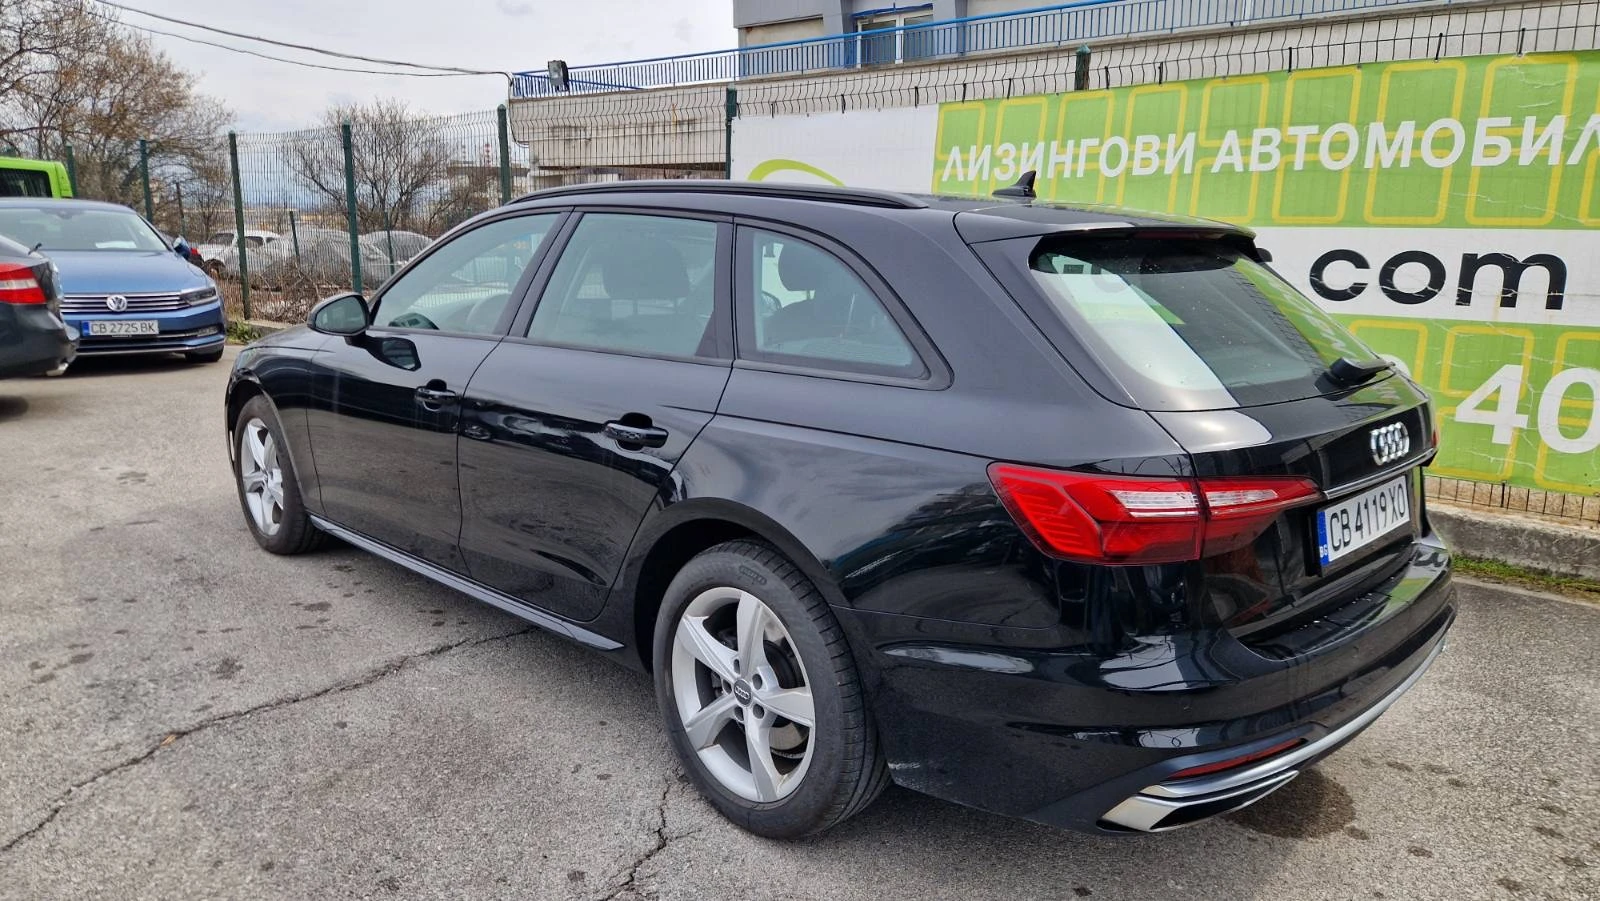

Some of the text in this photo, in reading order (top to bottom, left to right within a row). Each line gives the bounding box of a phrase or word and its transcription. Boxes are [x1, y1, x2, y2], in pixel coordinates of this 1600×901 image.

[942, 131, 1196, 182] ЛИЗИНГОВИ
[111, 321, 138, 334] 2725
[141, 321, 155, 333] BK
